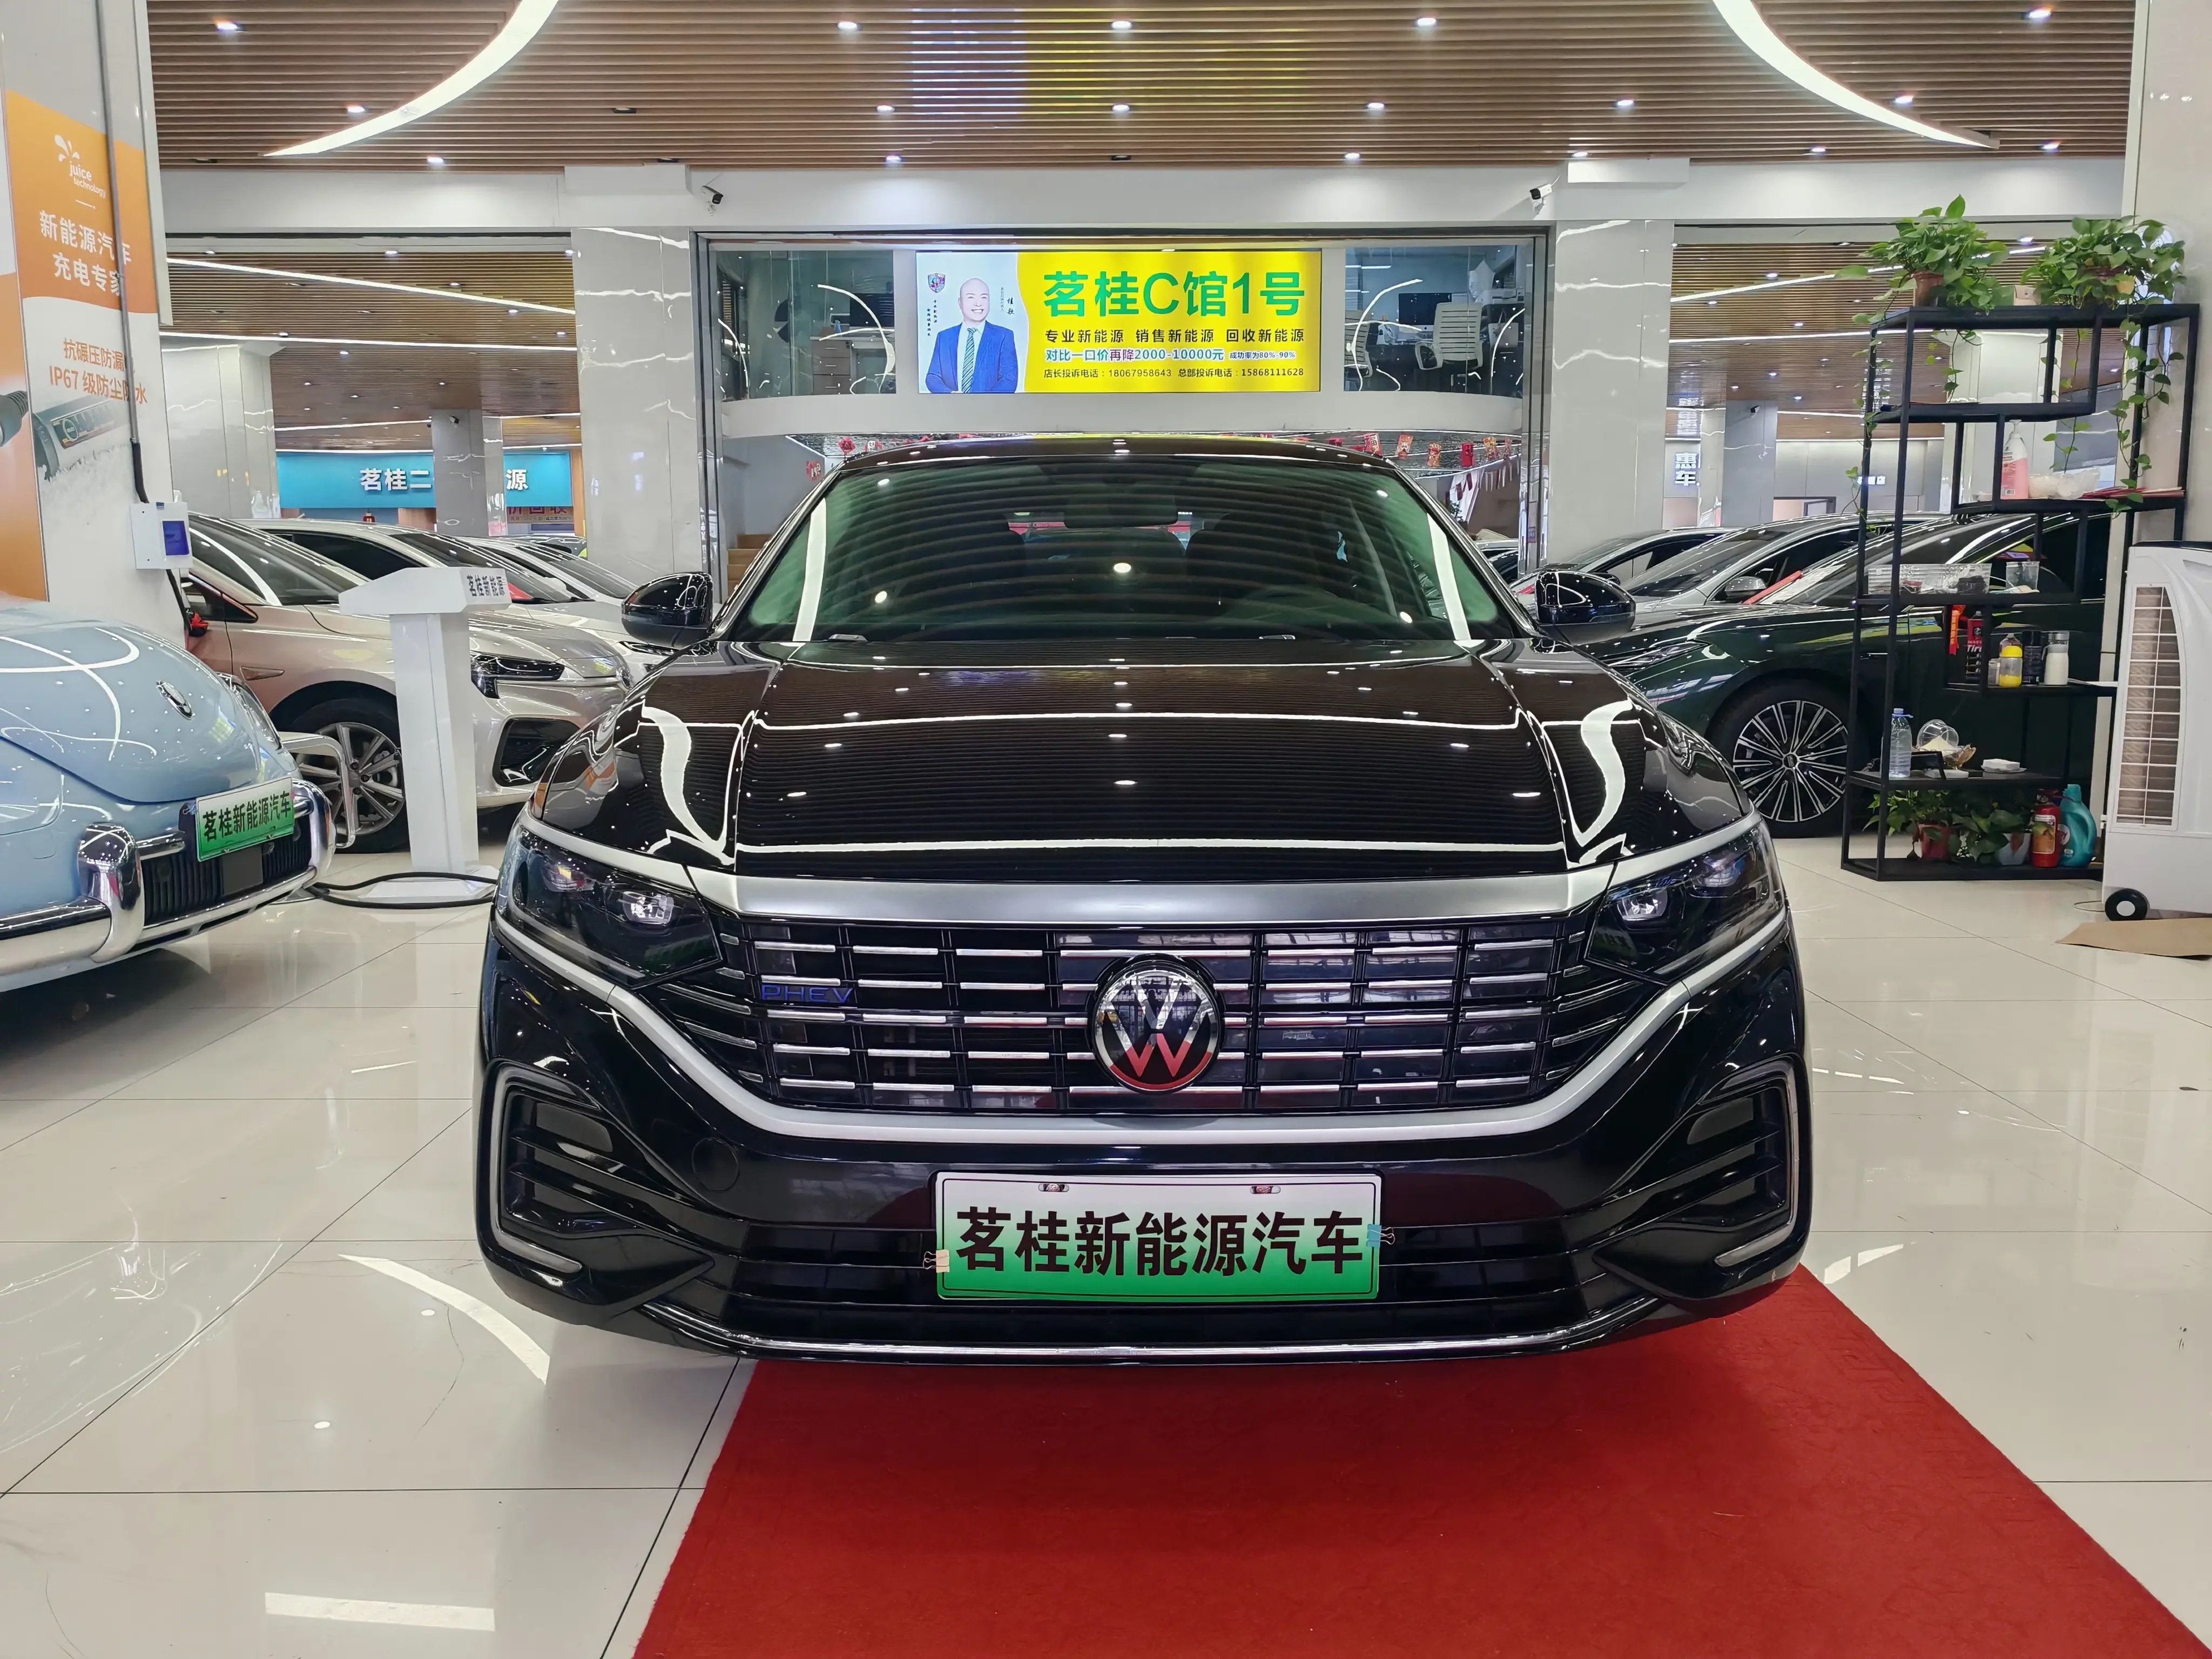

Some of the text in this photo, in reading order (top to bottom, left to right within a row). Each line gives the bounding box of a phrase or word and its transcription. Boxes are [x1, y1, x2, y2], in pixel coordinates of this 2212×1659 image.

[70, 160, 92, 181] juice
[74, 177, 105, 199] technology
[1044, 271, 1305, 316] 茗桂C馆1号
[1045, 328, 1305, 343] 专业新能源 销售新能源 回收新能源
[63, 338, 135, 374] 抗碾压防漏
[1046, 348, 1224, 362] 对比一口价再降2000-10000元
[50, 366, 79, 390] IP67
[202, 791, 291, 841] 茗桂新能源汽车
[761, 984, 853, 1003] PHEV
[956, 1206, 1363, 1277] 茗桂新能源汽车
